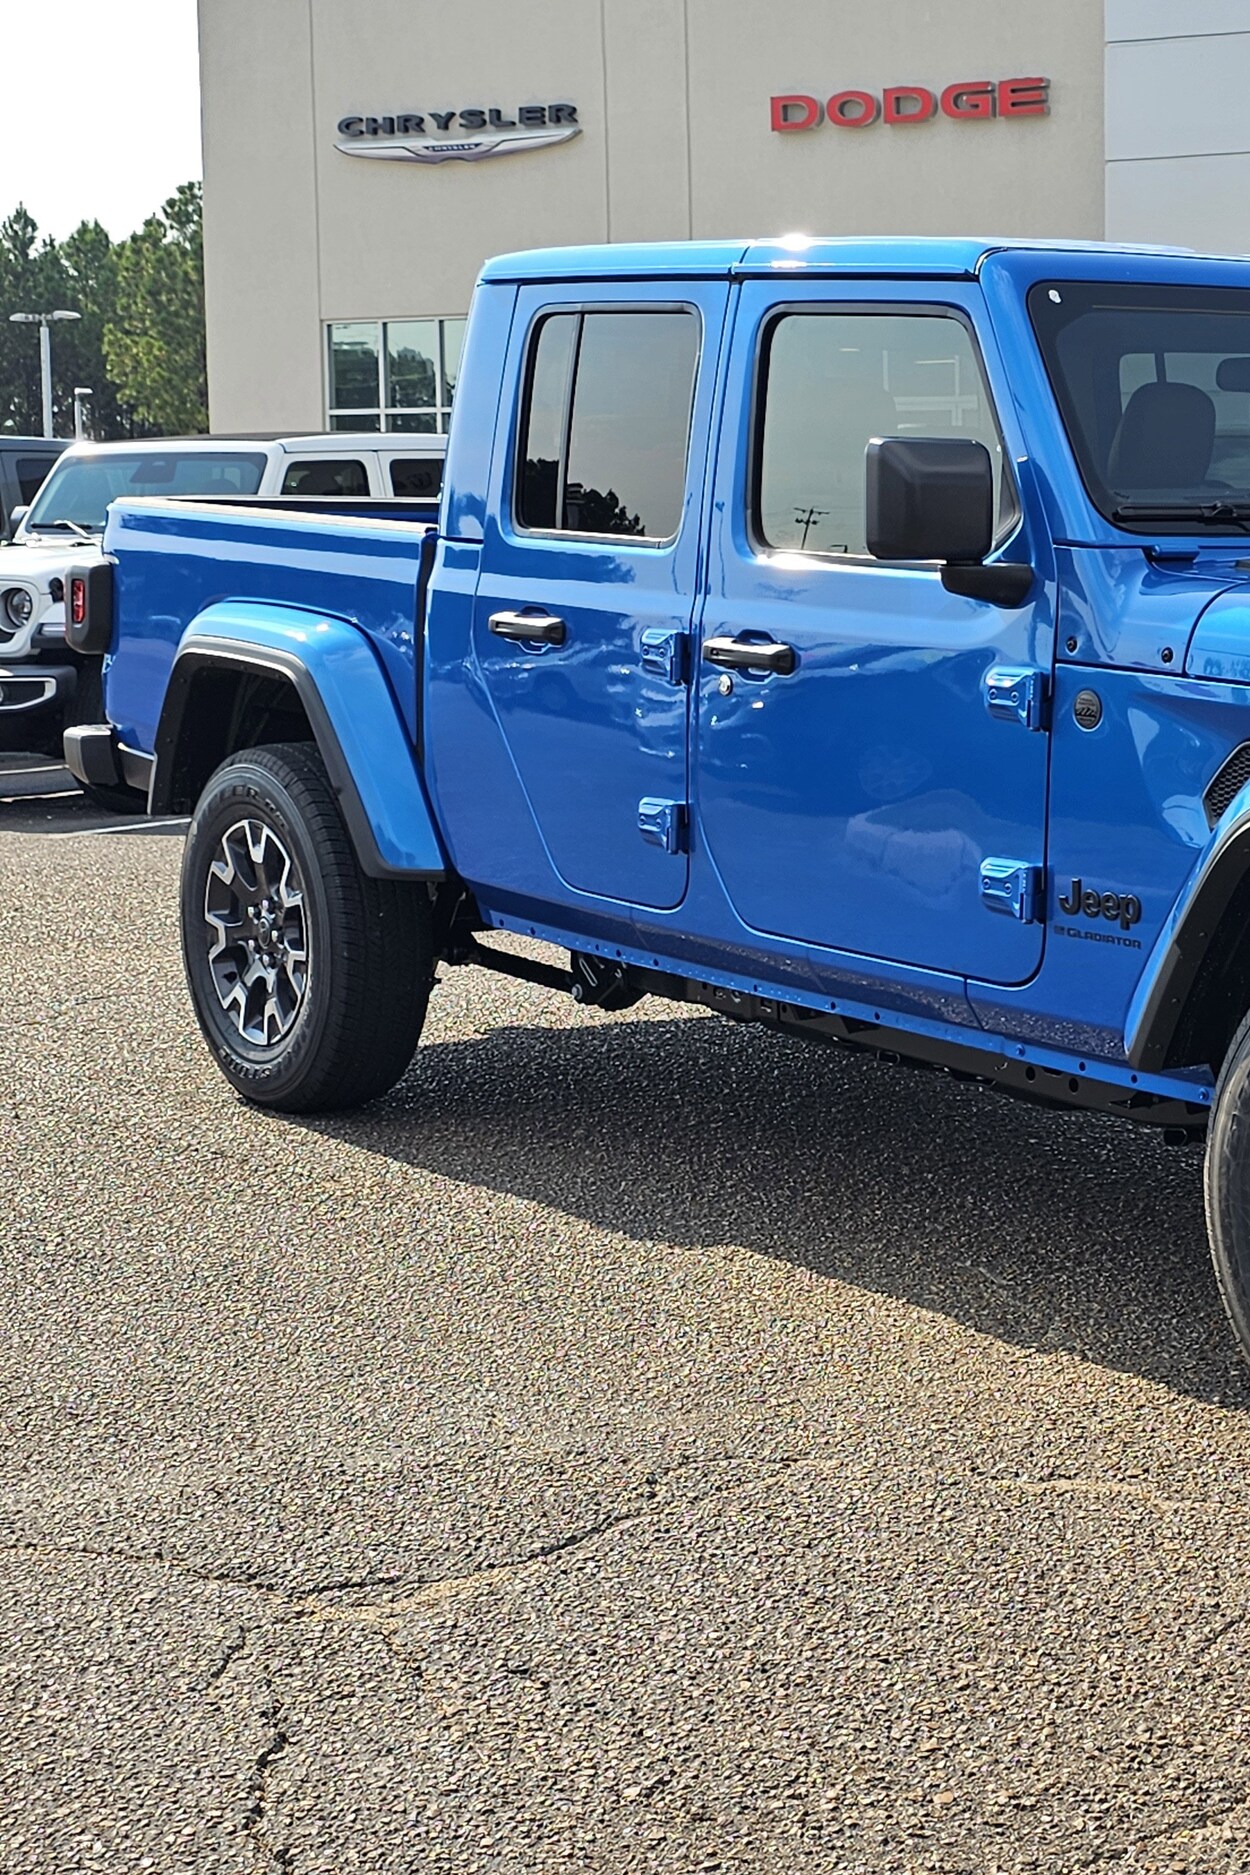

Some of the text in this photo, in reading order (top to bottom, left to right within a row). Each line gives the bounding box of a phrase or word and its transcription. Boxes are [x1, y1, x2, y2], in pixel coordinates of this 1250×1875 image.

[337, 104, 579, 137] CHRYSLER
[770, 76, 1050, 131] DODGE
[1058, 877, 1142, 930] Jeep
[1066, 927, 1142, 949] GLADIATOR
